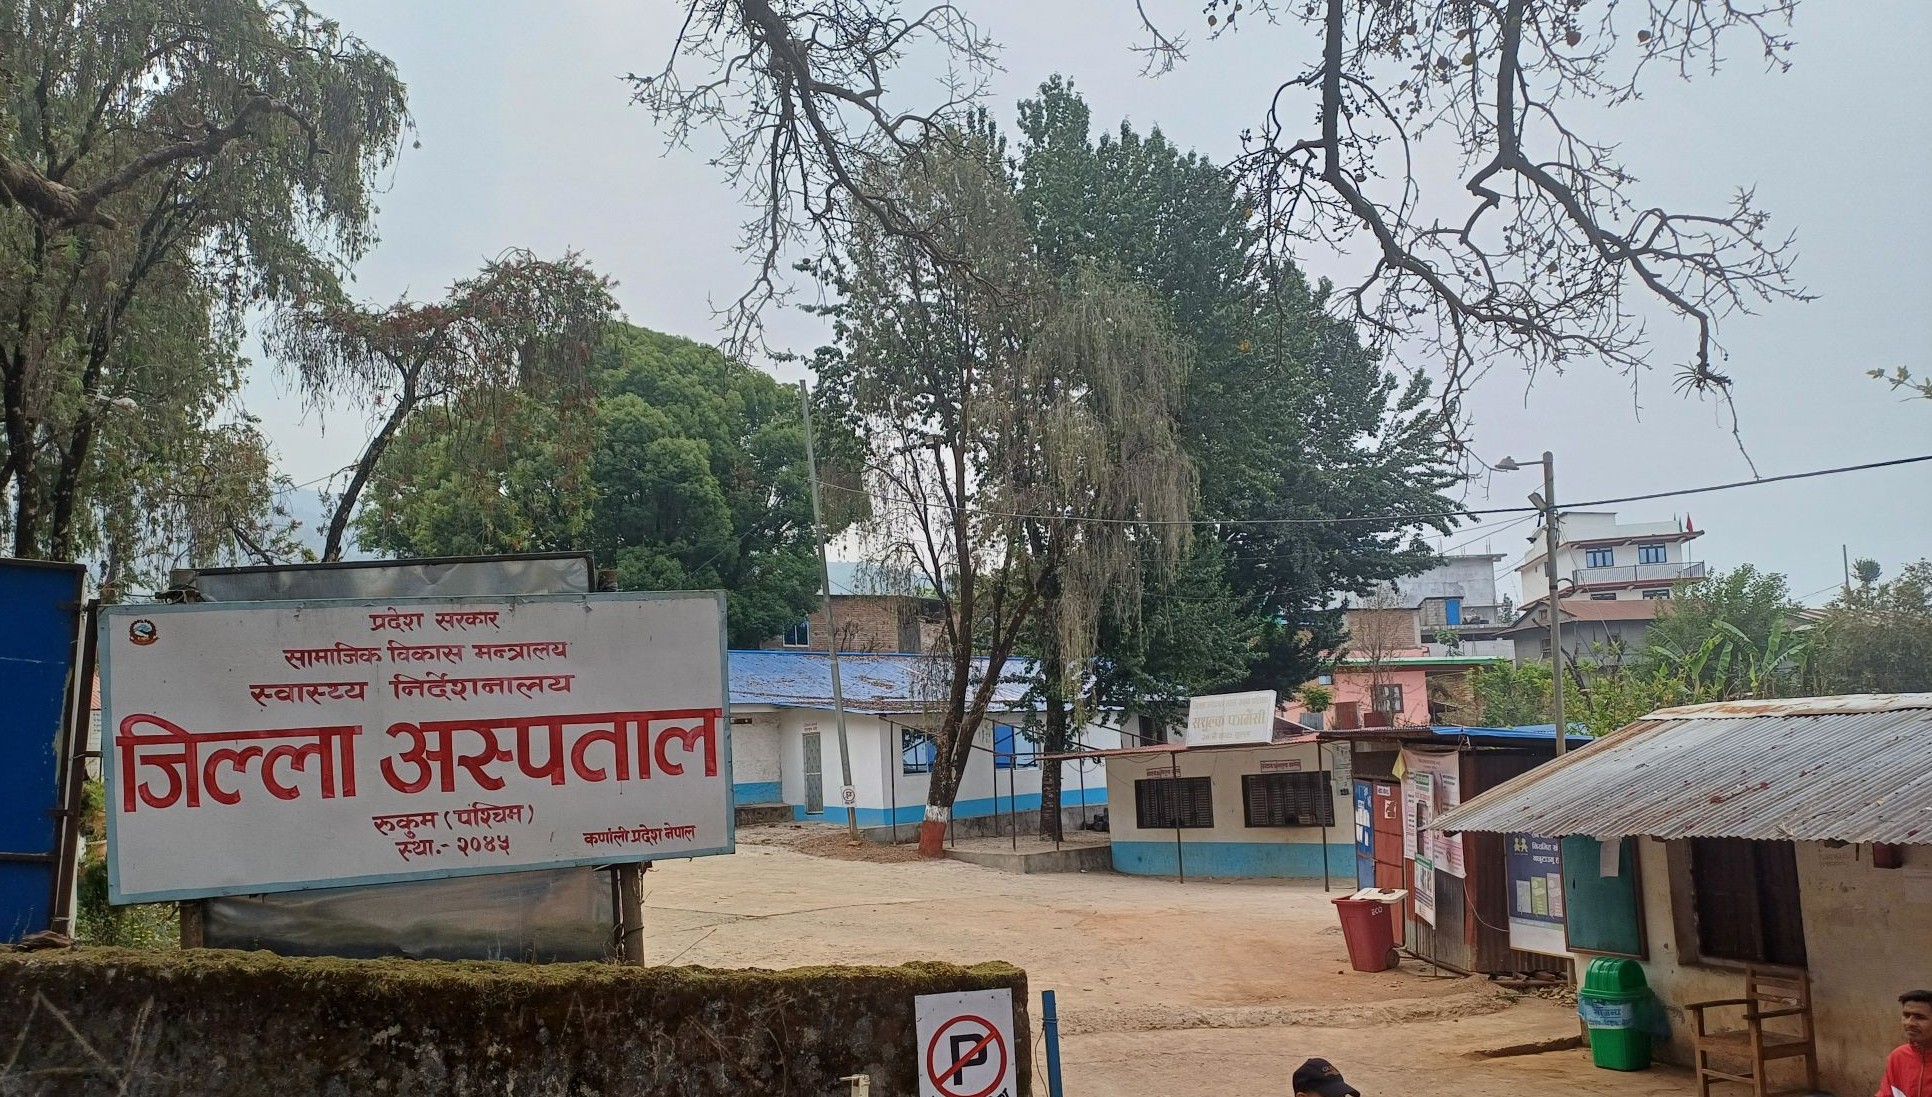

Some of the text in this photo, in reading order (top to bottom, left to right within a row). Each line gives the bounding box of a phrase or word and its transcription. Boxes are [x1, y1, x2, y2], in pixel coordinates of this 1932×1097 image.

[369, 607, 499, 632] प्रदेश सरकार
[283, 639, 568, 669] सामाजिक विकास मन्त्रालय
[389, 671, 575, 701] निर्देशनालय
[116, 707, 723, 813] जिल्ला अस्पताल
[457, 834, 510, 855] २०४५
[583, 822, 697, 846] कर्णाली प्रदेश नेपाल
[950, 1033, 987, 1086] P
